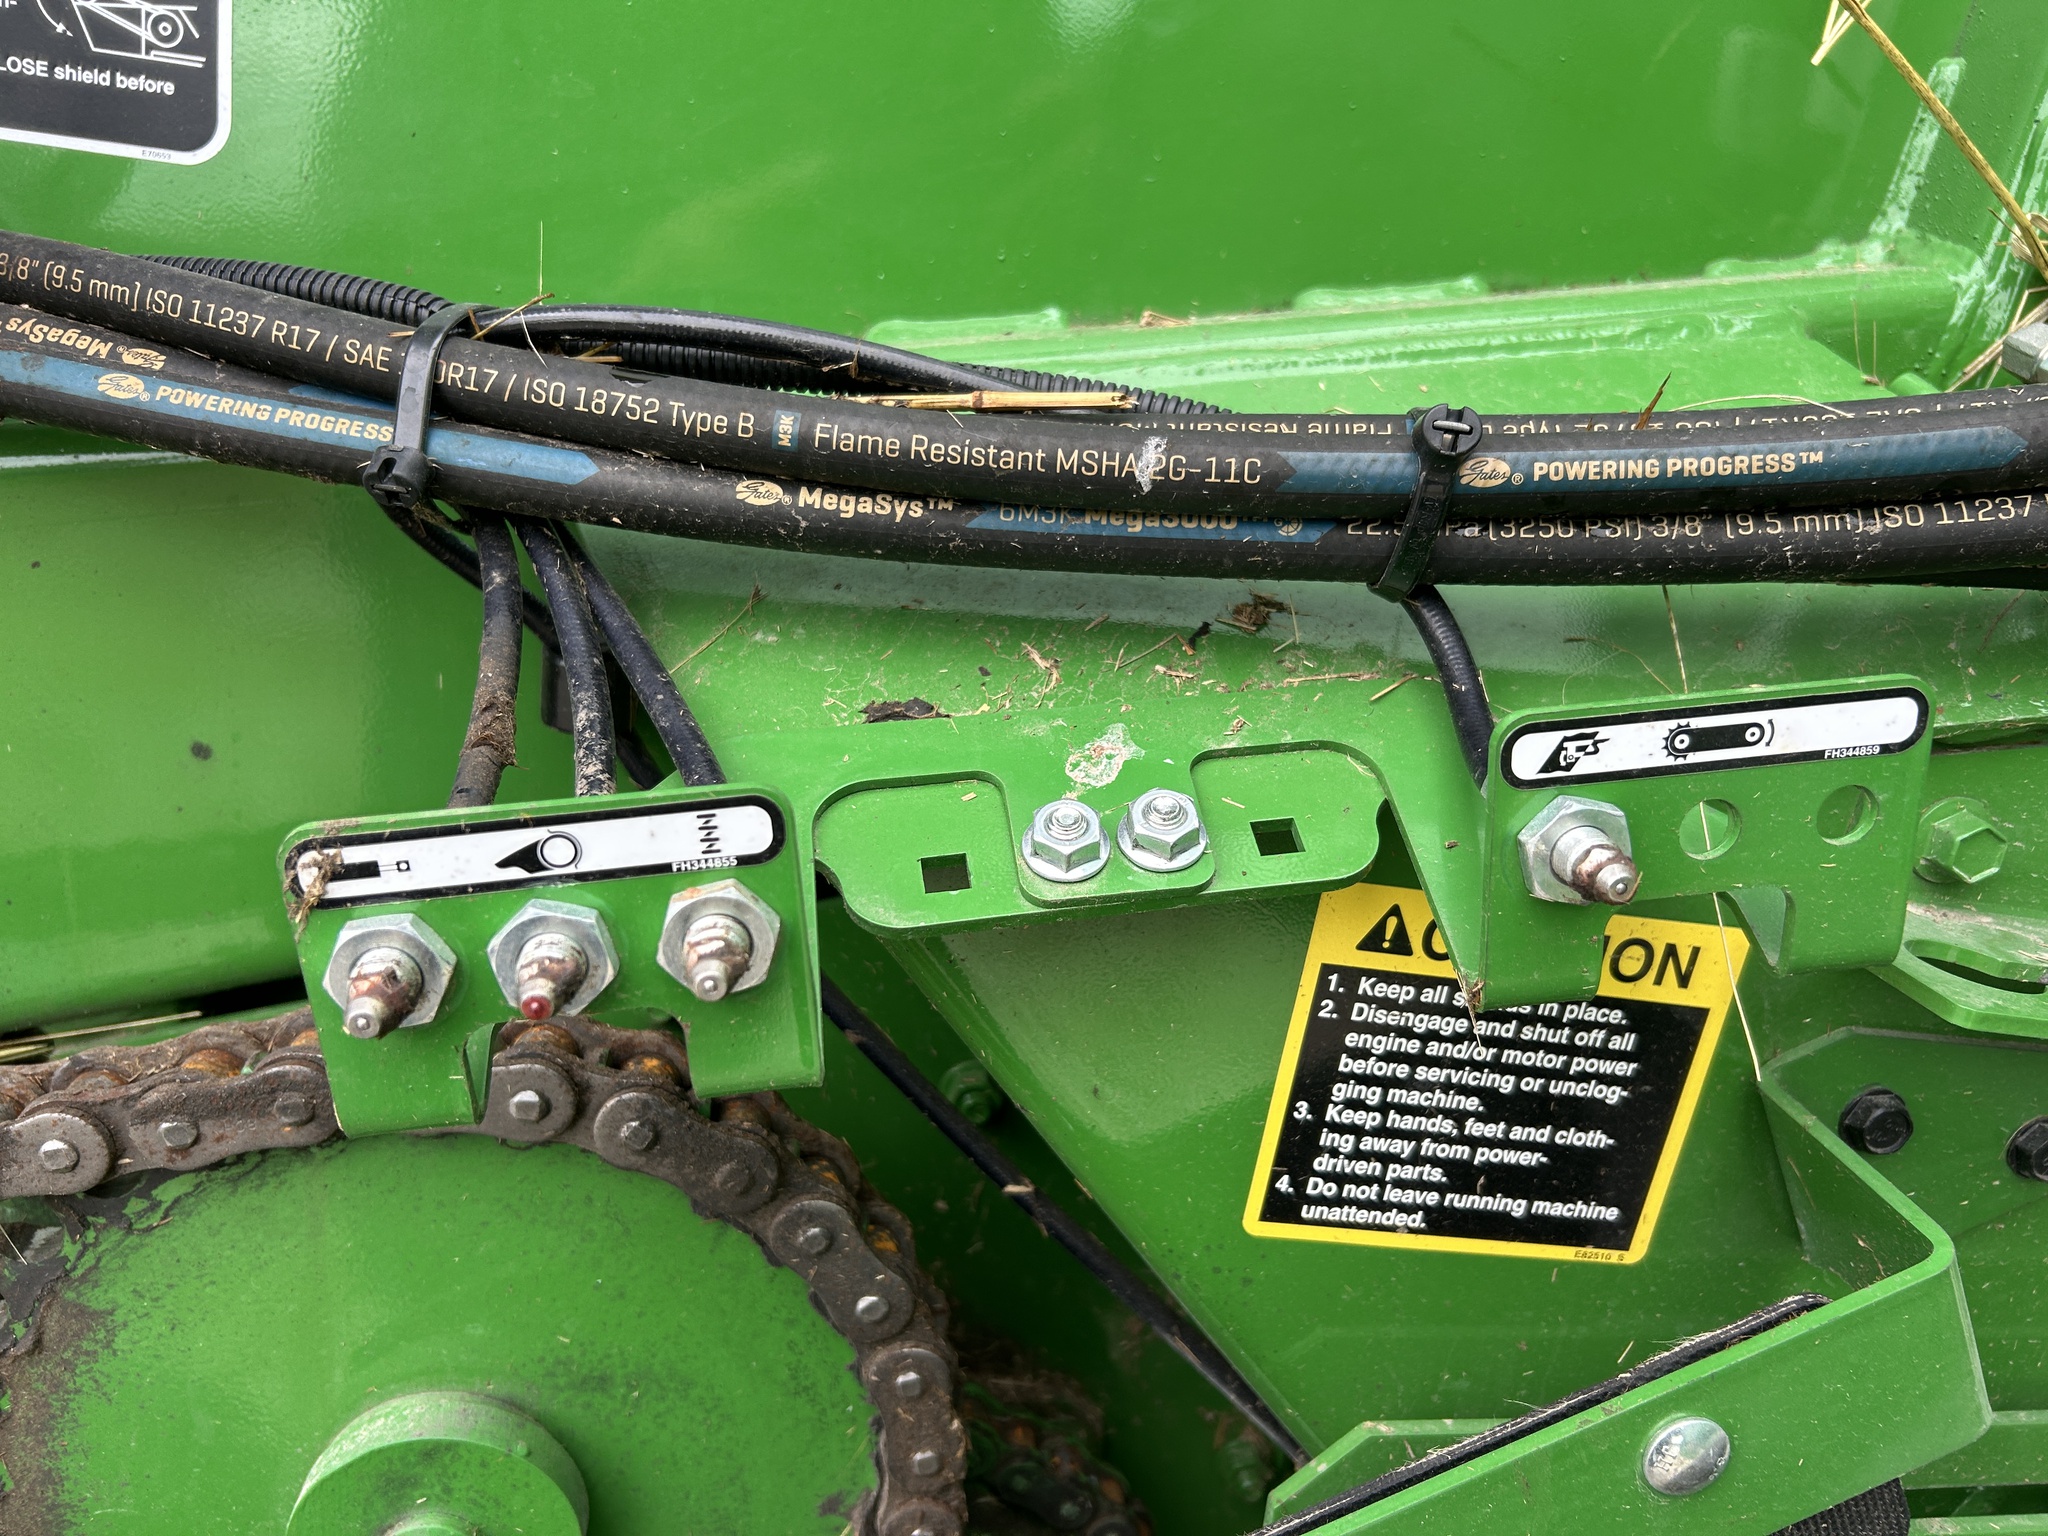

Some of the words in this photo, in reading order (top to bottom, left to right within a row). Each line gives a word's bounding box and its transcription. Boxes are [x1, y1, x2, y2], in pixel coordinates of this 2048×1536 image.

[54, 64, 111, 87] shield
[116, 71, 176, 96] before
[146, 287, 182, 318] ISO
[189, 299, 267, 340] 11237
[271, 319, 321, 353] R17
[325, 334, 338, 362] /
[344, 338, 393, 373] SAE
[503, 373, 517, 402] /
[523, 377, 566, 409] ISO
[574, 385, 660, 424] 18752
[669, 400, 728, 438] Type
[737, 411, 755, 438] B
[155, 385, 272, 421] POWERING
[274, 407, 394, 443] PROGRESS
[778, 414, 795, 447] M3K
[814, 423, 900, 459] Flame
[910, 433, 1046, 473] Resistant
[1056, 447, 1138, 479] MSHA
[1149, 454, 1262, 485] 2G-11C
[1533, 458, 1659, 482] POWERING
[1873, 503, 1924, 530] ISO
[1934, 494, 2032, 526] 11237
[1824, 745, 1880, 759] FH344859
[671, 856, 738, 872] FH344855
[1327, 973, 1345, 993] 1.
[1357, 976, 1415, 1005] Keep
[1420, 985, 1449, 1004] all
[1537, 1003, 1558, 1017] in
[1562, 1002, 1628, 1026] place.
[1318, 999, 1338, 1019] 2.
[1350, 1002, 1469, 1036] Disengage
[1473, 1019, 1518, 1039] and
[1520, 1022, 1571, 1044] shut
[1574, 1028, 1608, 1048] off
[1608, 1032, 1637, 1051] all
[1344, 1031, 1421, 1055] engine
[1425, 1040, 1497, 1062] and/or
[1501, 1048, 1568, 1069] motor
[1569, 1055, 1638, 1077] power
[1330, 1079, 1382, 1105] ging
[1386, 1088, 1485, 1112] machine.
[1338, 1053, 1411, 1079] before
[1414, 1065, 1516, 1094] servicing
[1520, 1076, 1546, 1092] or
[1549, 1079, 1629, 1105] unclog-
[1293, 1101, 1313, 1120] 3.
[1325, 1104, 1382, 1130] Keep
[1386, 1109, 1459, 1137] hands,
[1463, 1117, 1507, 1139] feet
[1509, 1125, 1552, 1143] and
[1554, 1127, 1616, 1148] cloth-
[1319, 1128, 1355, 1152] ing
[1359, 1134, 1417, 1158] away
[1420, 1138, 1470, 1159] from
[1473, 1146, 1549, 1166] power-
[1313, 1153, 1382, 1177] driven
[1385, 1163, 1448, 1183] parts.
[1275, 1174, 1295, 1193] 4.
[1305, 1177, 1338, 1197] Do
[1342, 1182, 1380, 1201] not
[1383, 1183, 1440, 1205] leave
[1444, 1192, 1528, 1218] running
[1531, 1200, 1620, 1222] machine
[1300, 1204, 1427, 1228] unattended.
